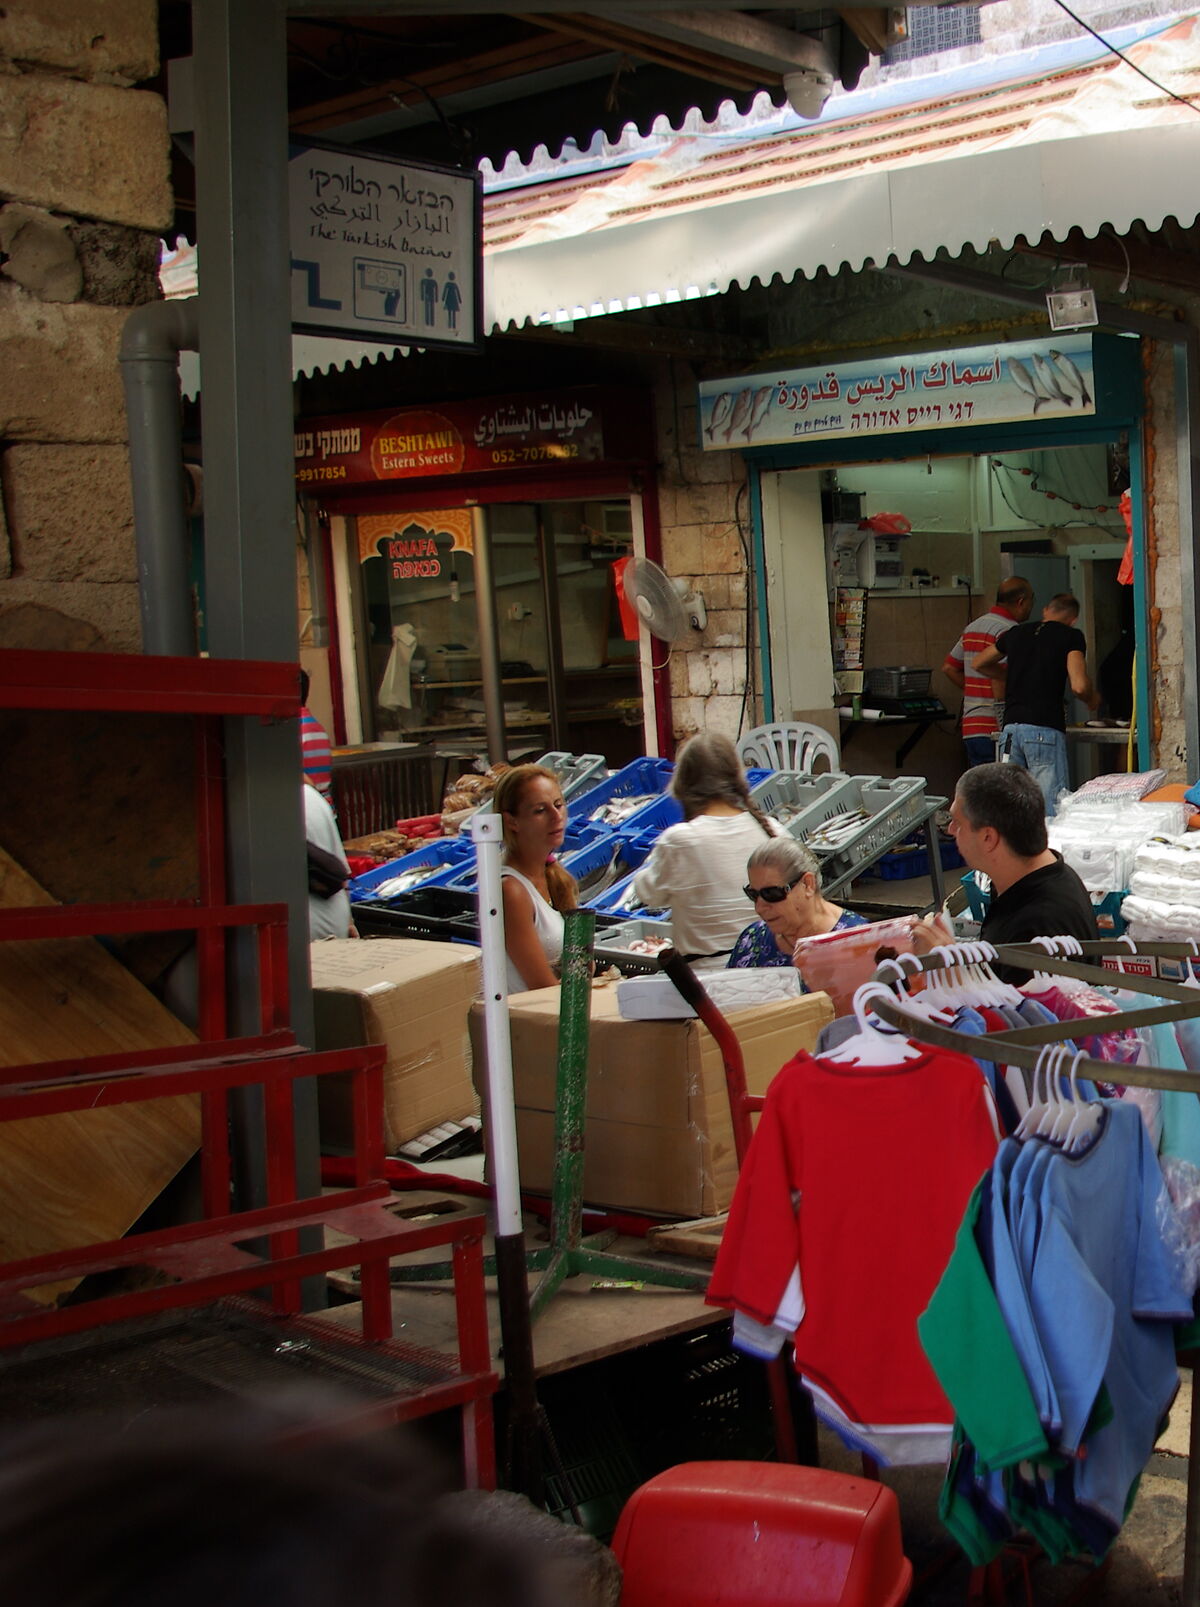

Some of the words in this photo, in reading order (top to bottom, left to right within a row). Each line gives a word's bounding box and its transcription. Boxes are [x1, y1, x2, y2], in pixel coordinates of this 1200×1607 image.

[309, 165, 382, 198] הטורקי
[388, 176, 454, 212] הבזאר
[310, 196, 380, 223] التركي
[393, 209, 450, 234] البازار
[310, 223, 336, 240] The
[342, 229, 397, 250] Turkish
[776, 372, 840, 412] قدورة
[846, 367, 915, 405] الريس
[538, 401, 593, 438] حلويات
[907, 405, 941, 424] רייס
[949, 401, 973, 420] דגי
[473, 406, 538, 447] البشتاوي
[317, 428, 361, 461] ממתקי
[379, 430, 455, 455] BESHTAWI
[382, 454, 416, 471] Estern
[418, 453, 455, 468] Sweets
[389, 538, 438, 560] KNAFA
[392, 559, 441, 580] כנאפה
